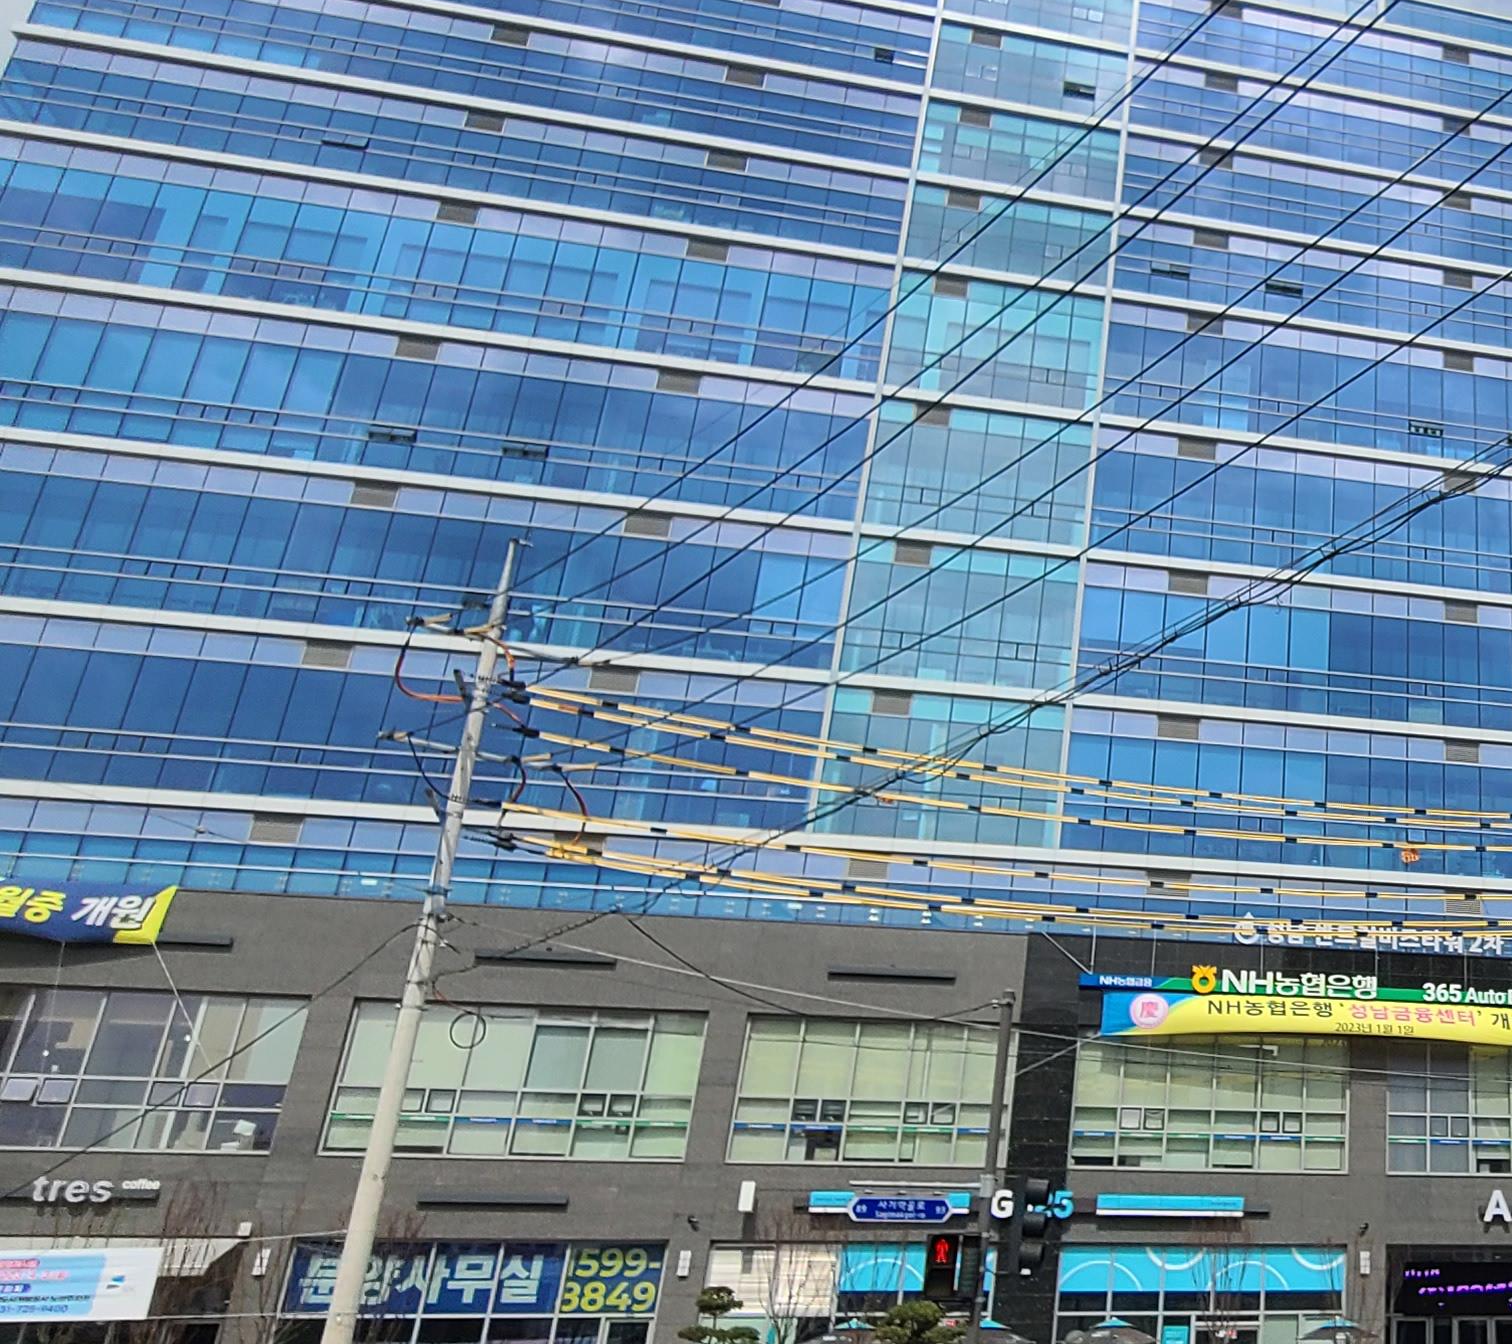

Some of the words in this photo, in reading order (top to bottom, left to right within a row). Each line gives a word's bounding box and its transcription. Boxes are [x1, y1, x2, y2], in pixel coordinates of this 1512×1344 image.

[70, 895, 156, 930] 개원
[1220, 969, 1378, 1000] NH농협은행
[1422, 982, 1462, 1003] 365
[1207, 1000, 1333, 1018] NH농협은행
[1335, 1022, 1373, 1034] 2023년
[1397, 1025, 1415, 1036] 1일
[32, 1175, 114, 1203] tres
[121, 1178, 161, 1190] coffee
